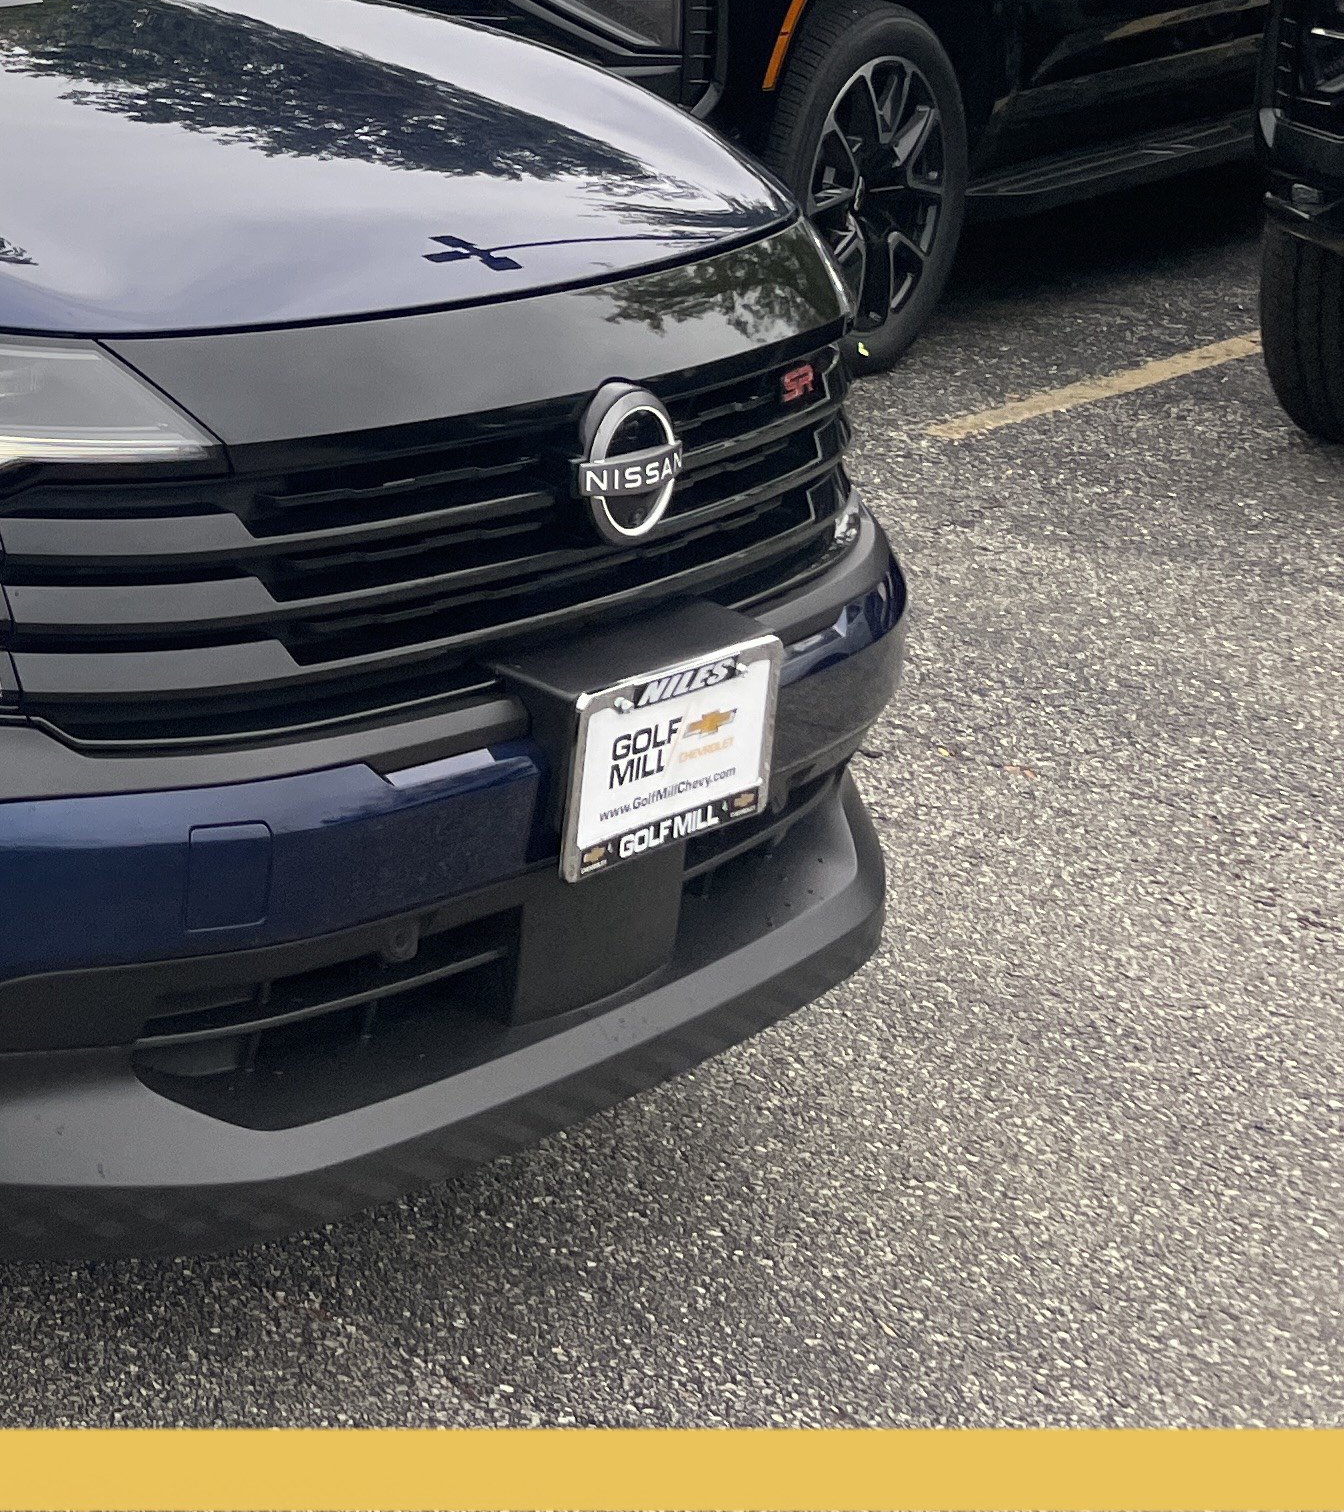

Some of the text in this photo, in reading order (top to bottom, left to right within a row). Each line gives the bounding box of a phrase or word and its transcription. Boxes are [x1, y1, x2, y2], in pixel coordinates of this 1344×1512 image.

[781, 364, 815, 402] SR
[585, 447, 683, 491] NISSAN
[637, 656, 737, 707] NILES
[612, 716, 683, 761] GOLF
[608, 748, 666, 789] MILL
[599, 767, 737, 822] www.GolfMillChevy.com
